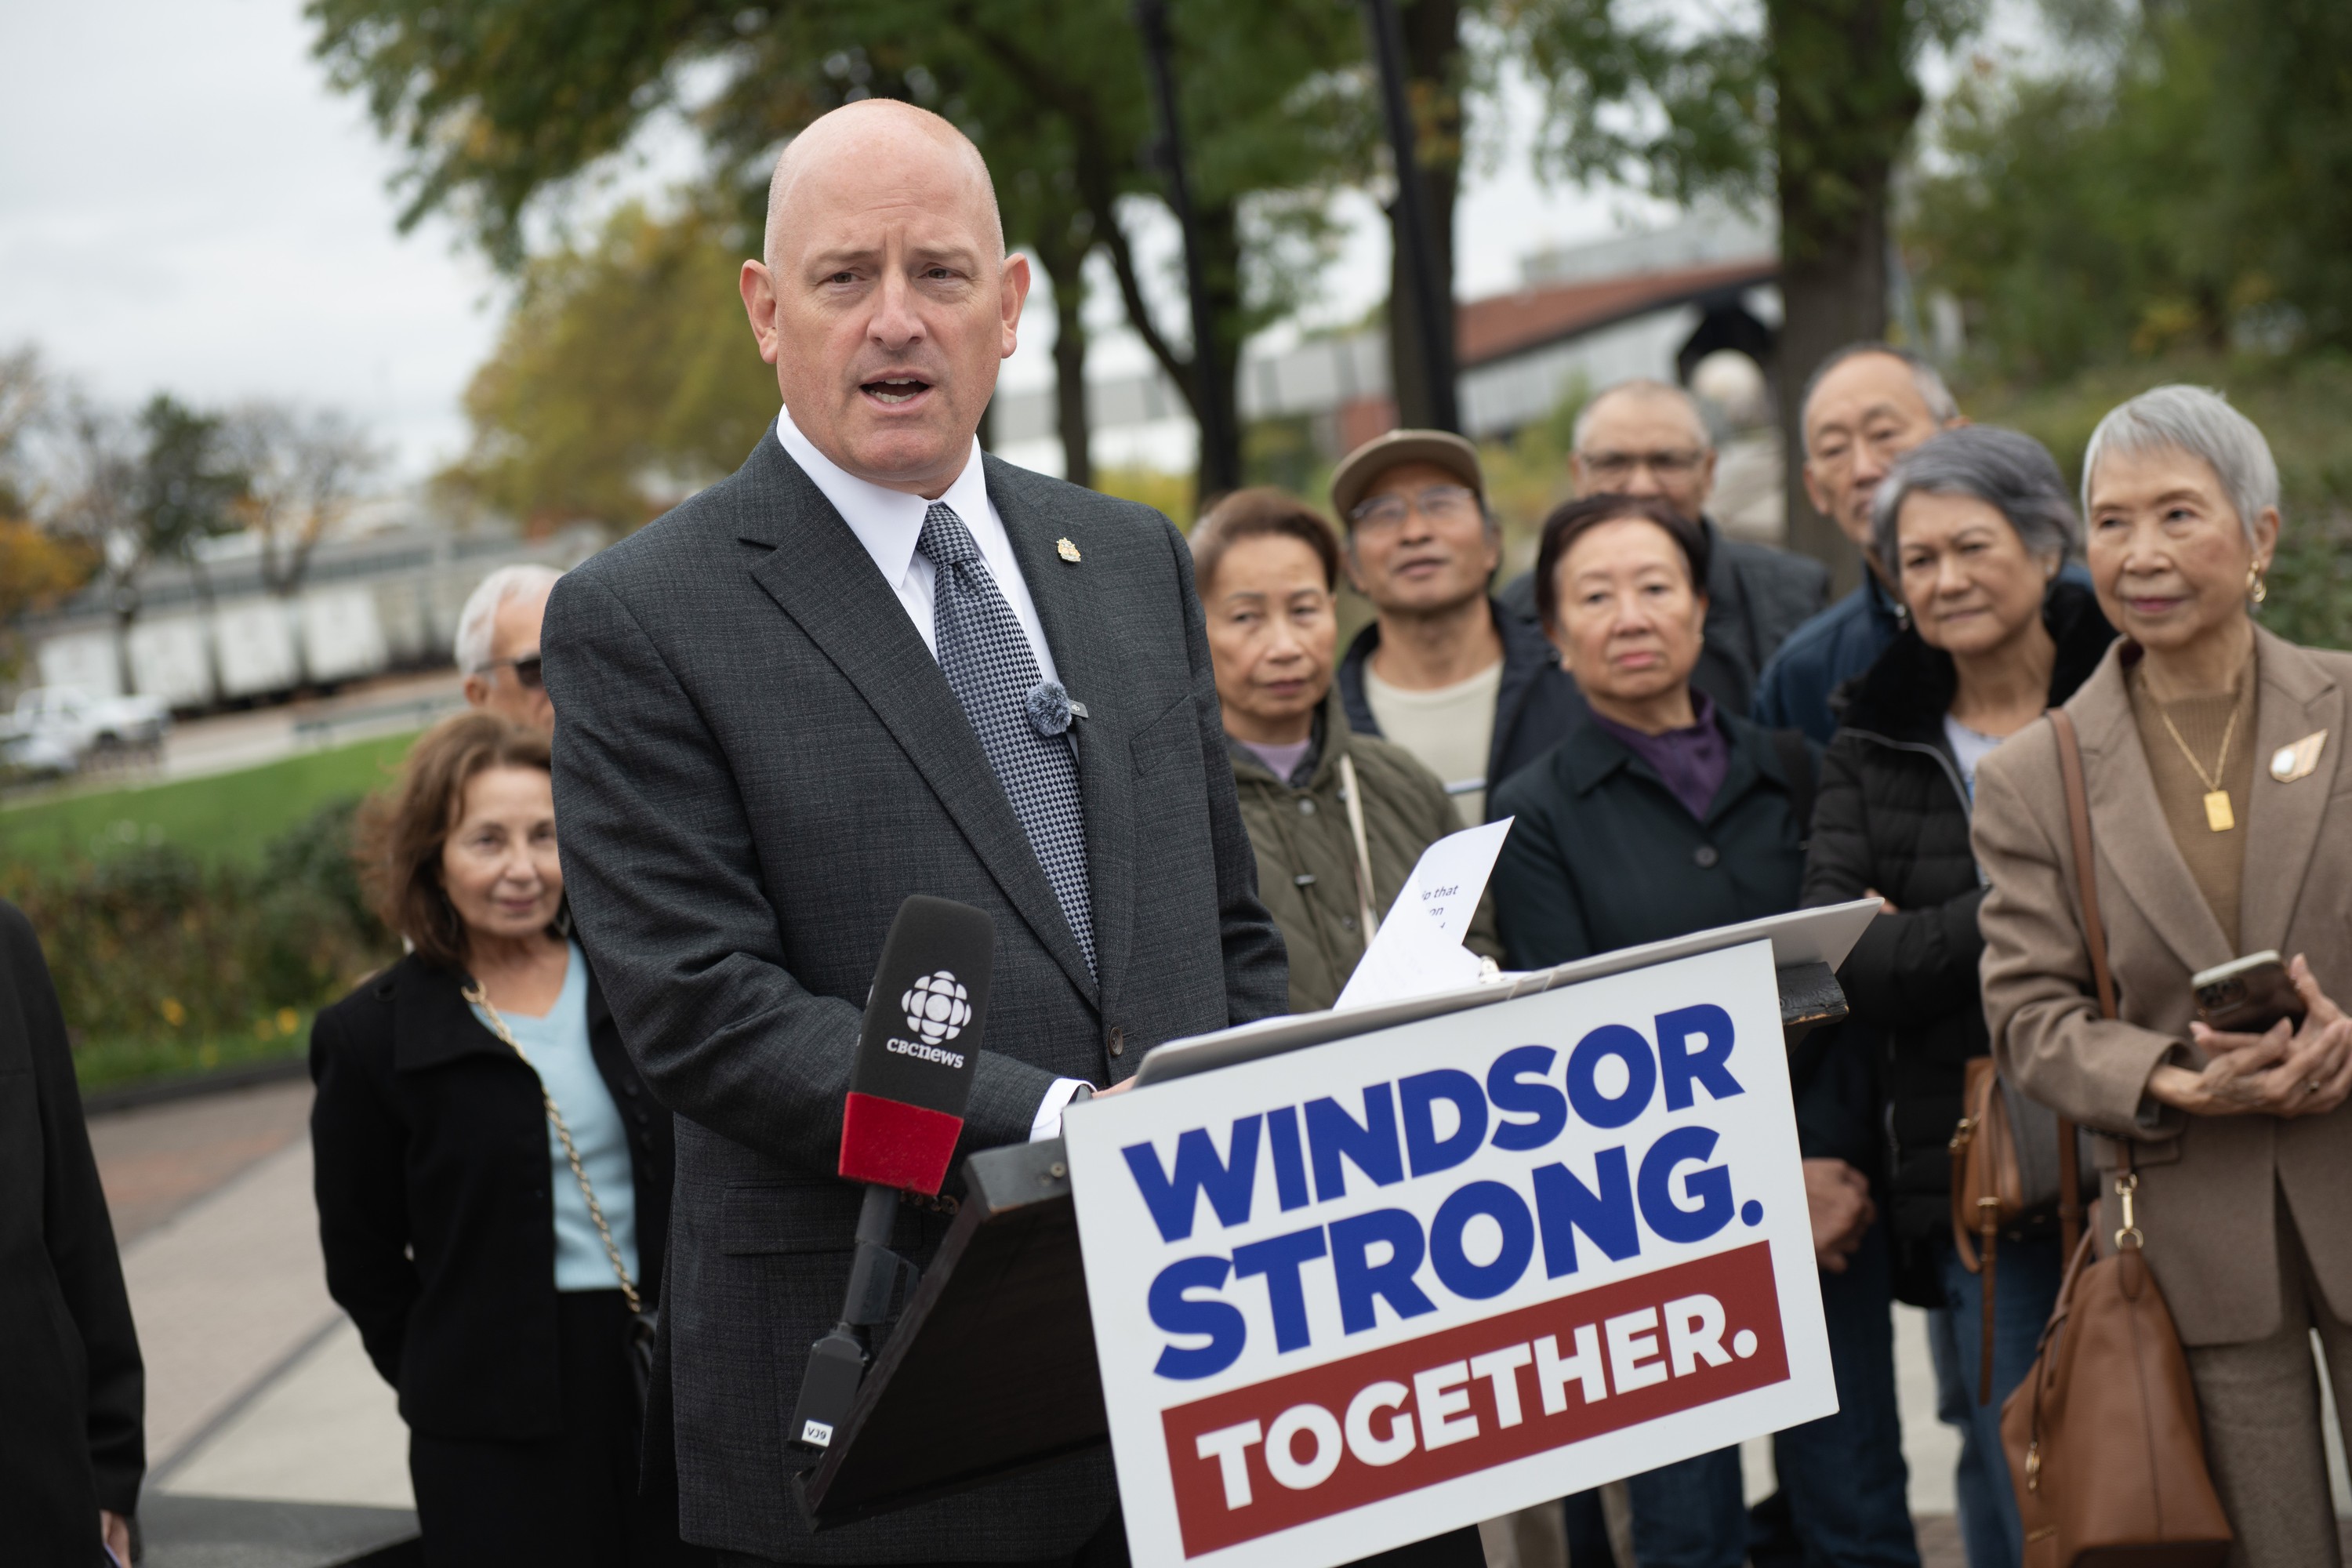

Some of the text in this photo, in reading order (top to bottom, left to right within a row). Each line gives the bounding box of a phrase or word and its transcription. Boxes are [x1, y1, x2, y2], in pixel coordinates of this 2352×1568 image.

[1434, 885, 1458, 898] that
[1121, 1004, 1746, 1244] WINDSOR
[1147, 1125, 1765, 1381] STRONG.
[807, 1427, 827, 1440] VJ9
[1196, 1294, 1758, 1510] TOGETHER.
